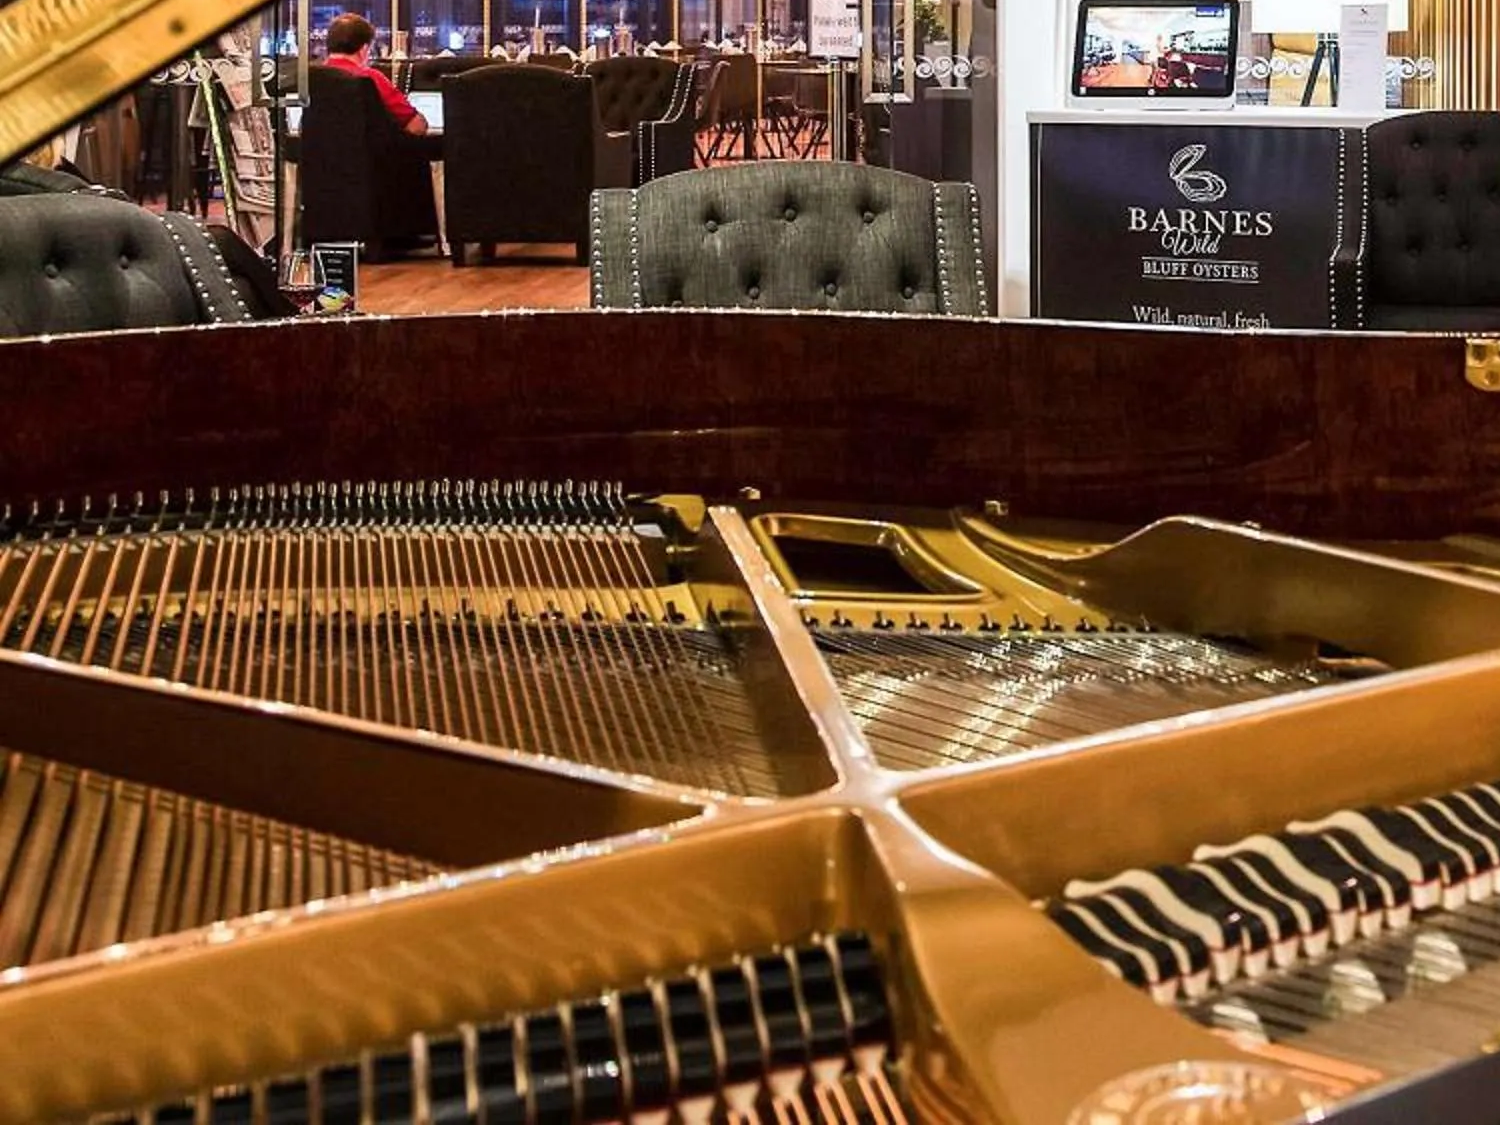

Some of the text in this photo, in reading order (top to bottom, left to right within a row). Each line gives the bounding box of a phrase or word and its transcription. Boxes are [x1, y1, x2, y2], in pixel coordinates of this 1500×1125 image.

[1127, 207, 1273, 236] BARNES
[1161, 226, 1222, 255] Wild
[1143, 260, 1260, 279] BLUFF OYSTERS
